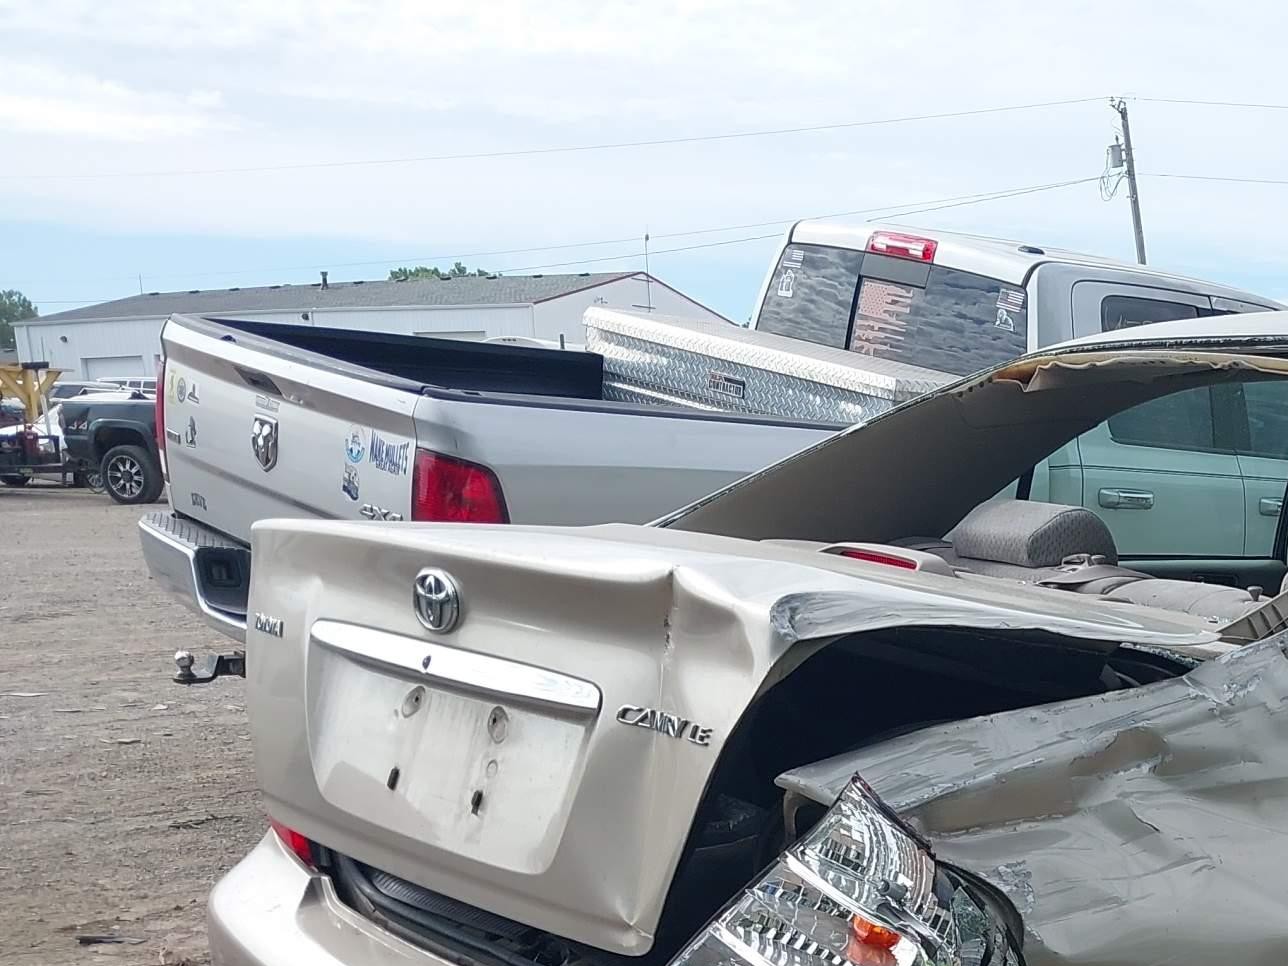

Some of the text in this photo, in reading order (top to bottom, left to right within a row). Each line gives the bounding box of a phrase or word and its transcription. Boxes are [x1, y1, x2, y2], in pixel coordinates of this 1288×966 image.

[708, 379, 743, 398] CONTRACTOR
[255, 611, 284, 638] TOYOTA
[616, 703, 714, 747] CAMRY LE
